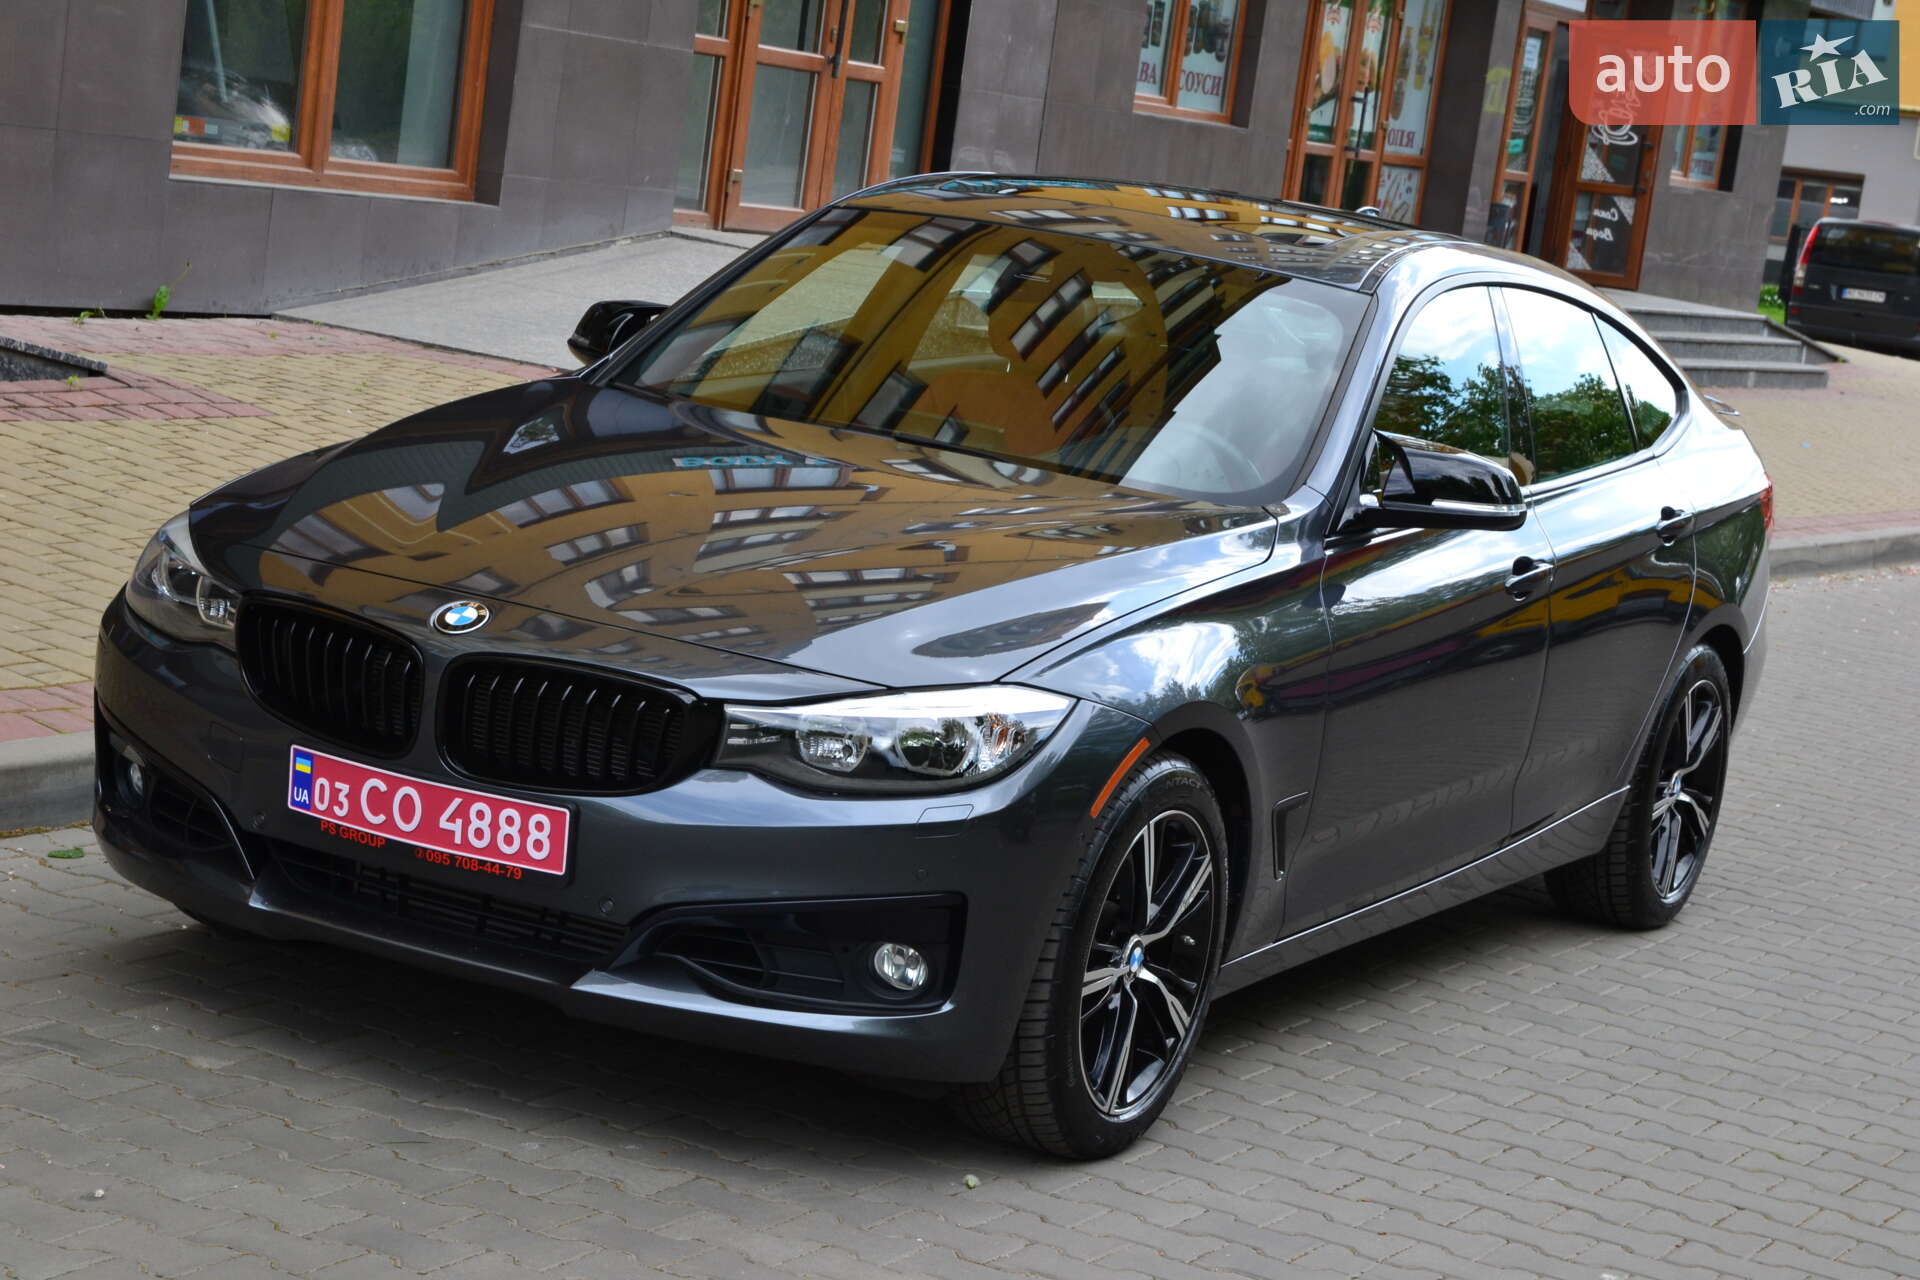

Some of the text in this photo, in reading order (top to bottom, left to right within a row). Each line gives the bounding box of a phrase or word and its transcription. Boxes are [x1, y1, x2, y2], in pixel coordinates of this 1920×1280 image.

[1137, 61, 1157, 84] ВА
[293, 786, 310, 805] UA
[314, 777, 551, 861] 03 CO 4888
[320, 820, 386, 849] PS GROUP
[454, 855, 522, 880] 708-44-79
